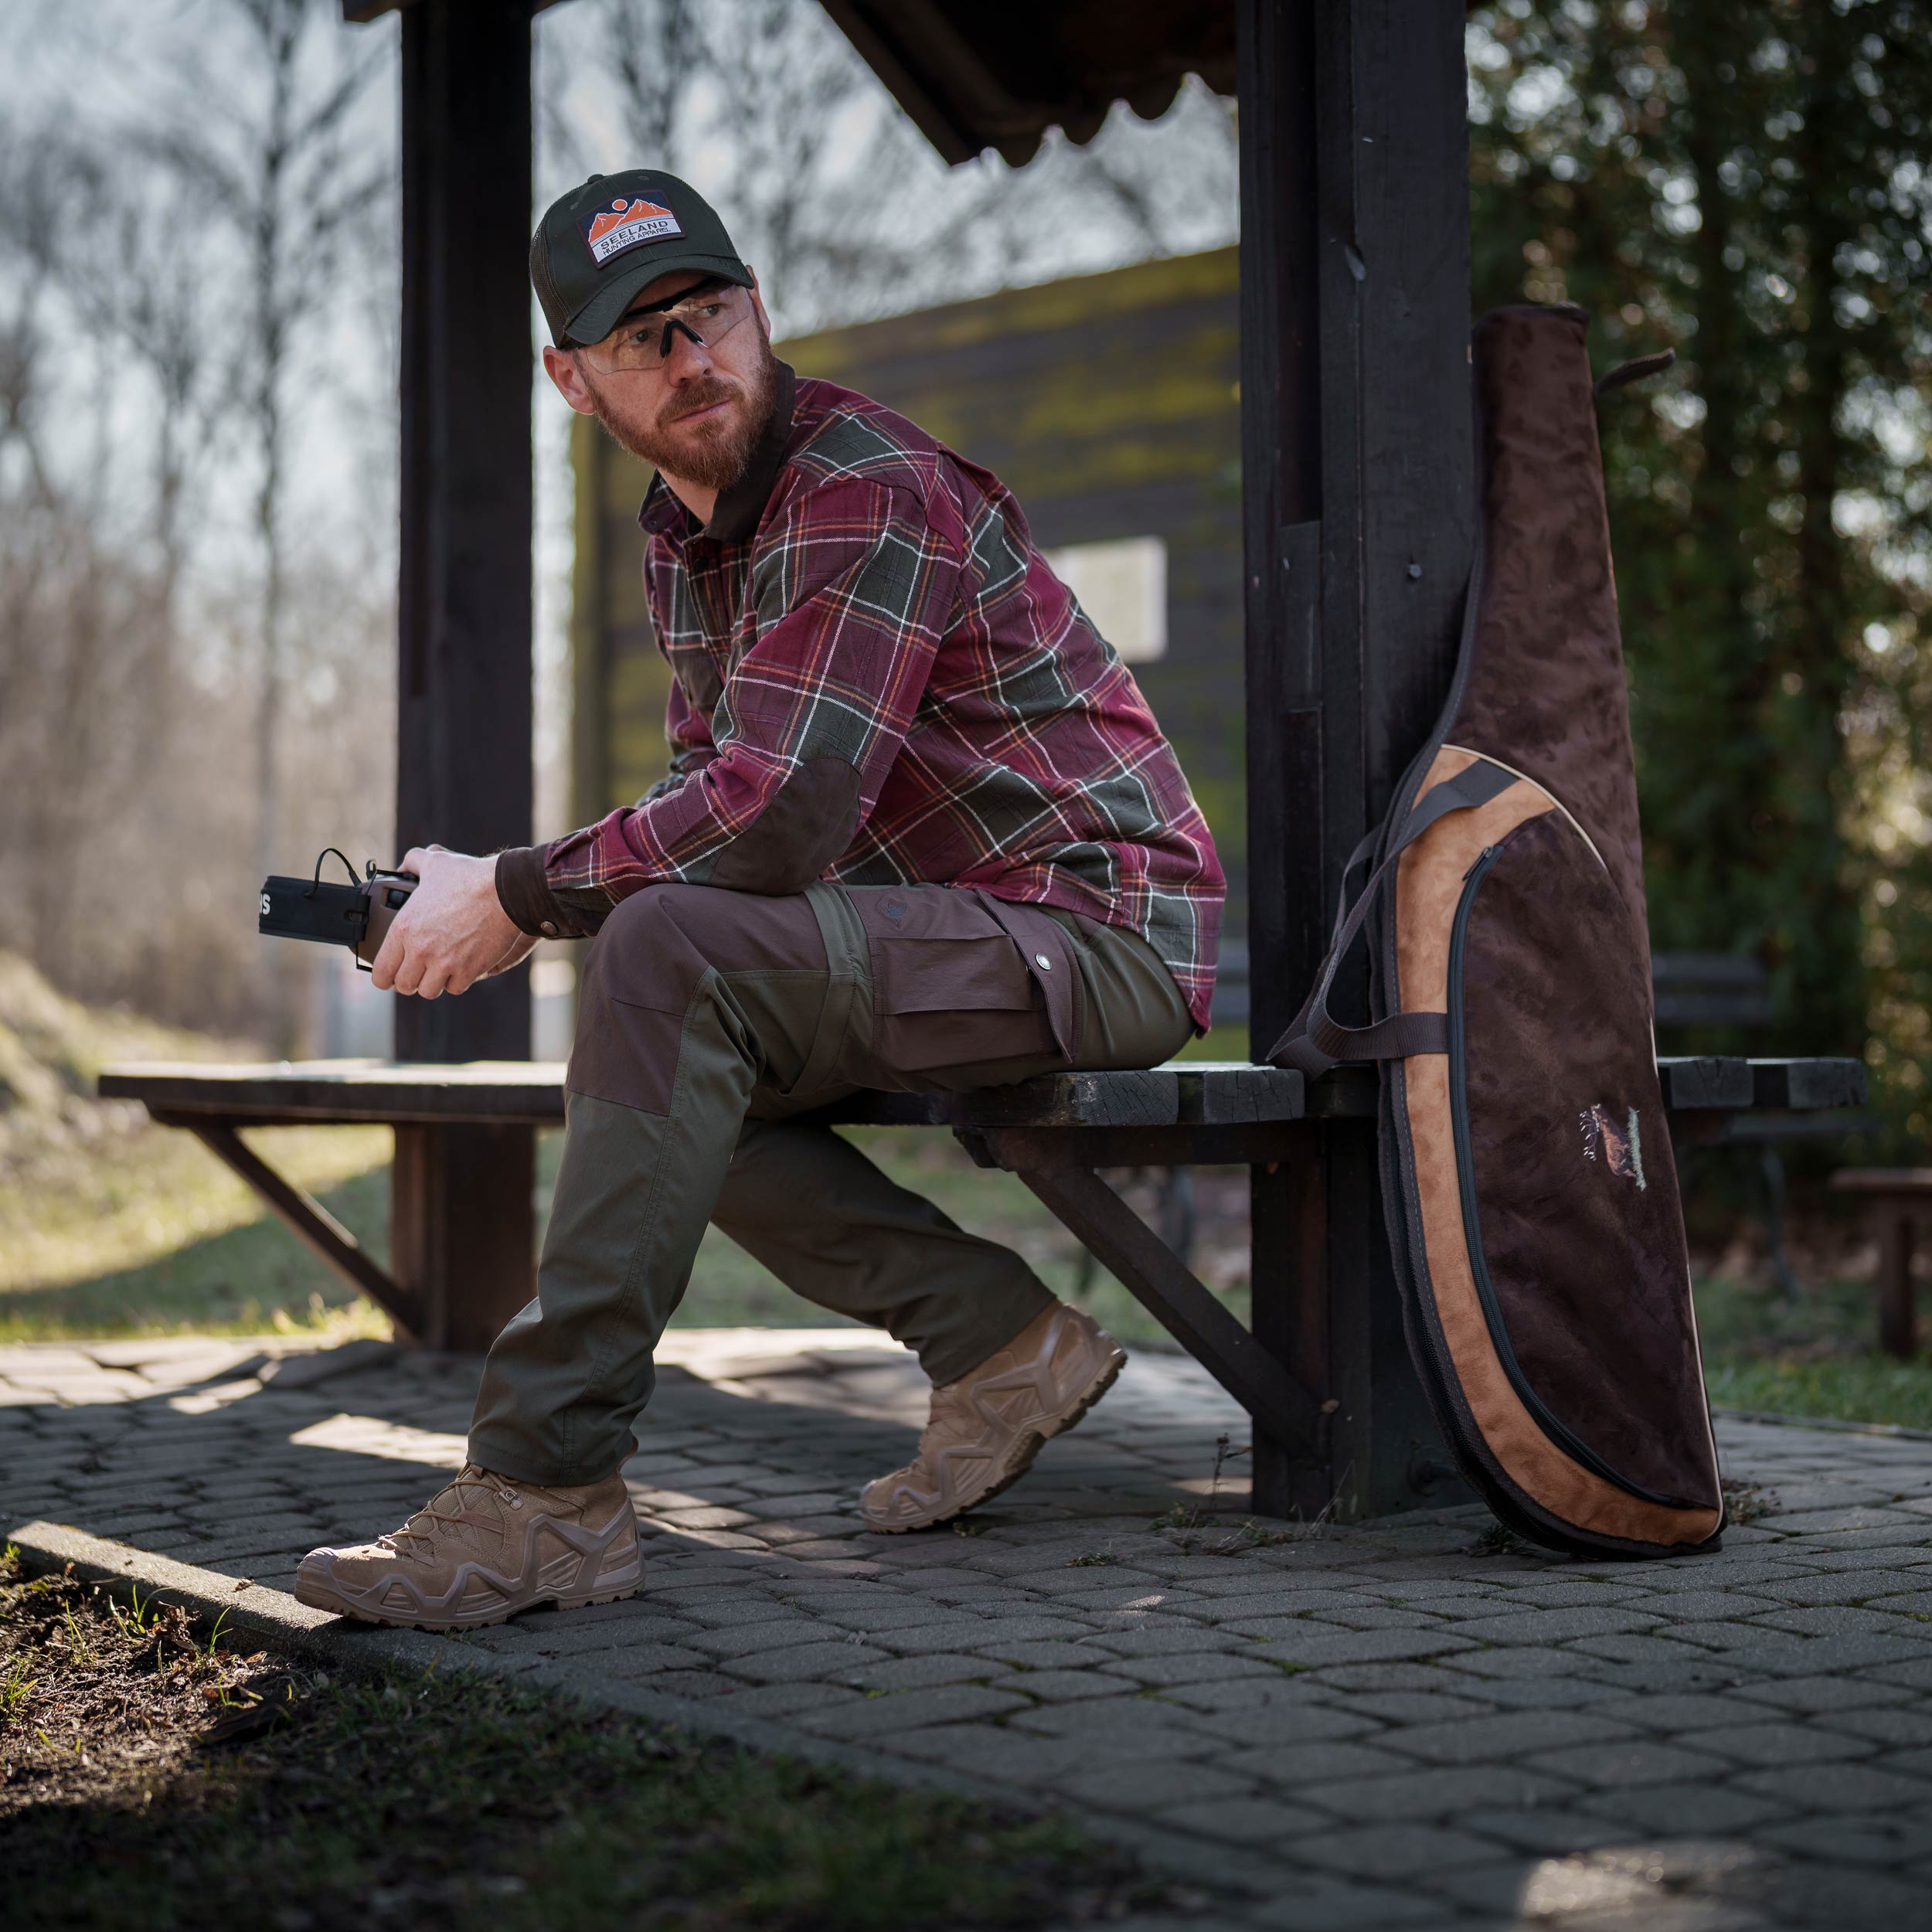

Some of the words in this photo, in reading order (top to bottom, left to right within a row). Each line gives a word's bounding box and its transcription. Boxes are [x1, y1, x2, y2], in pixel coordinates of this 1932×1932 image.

[601, 221, 668, 250] SEELAND
[603, 236, 635, 256] HUNTING
[638, 227, 671, 240] APPAREL
